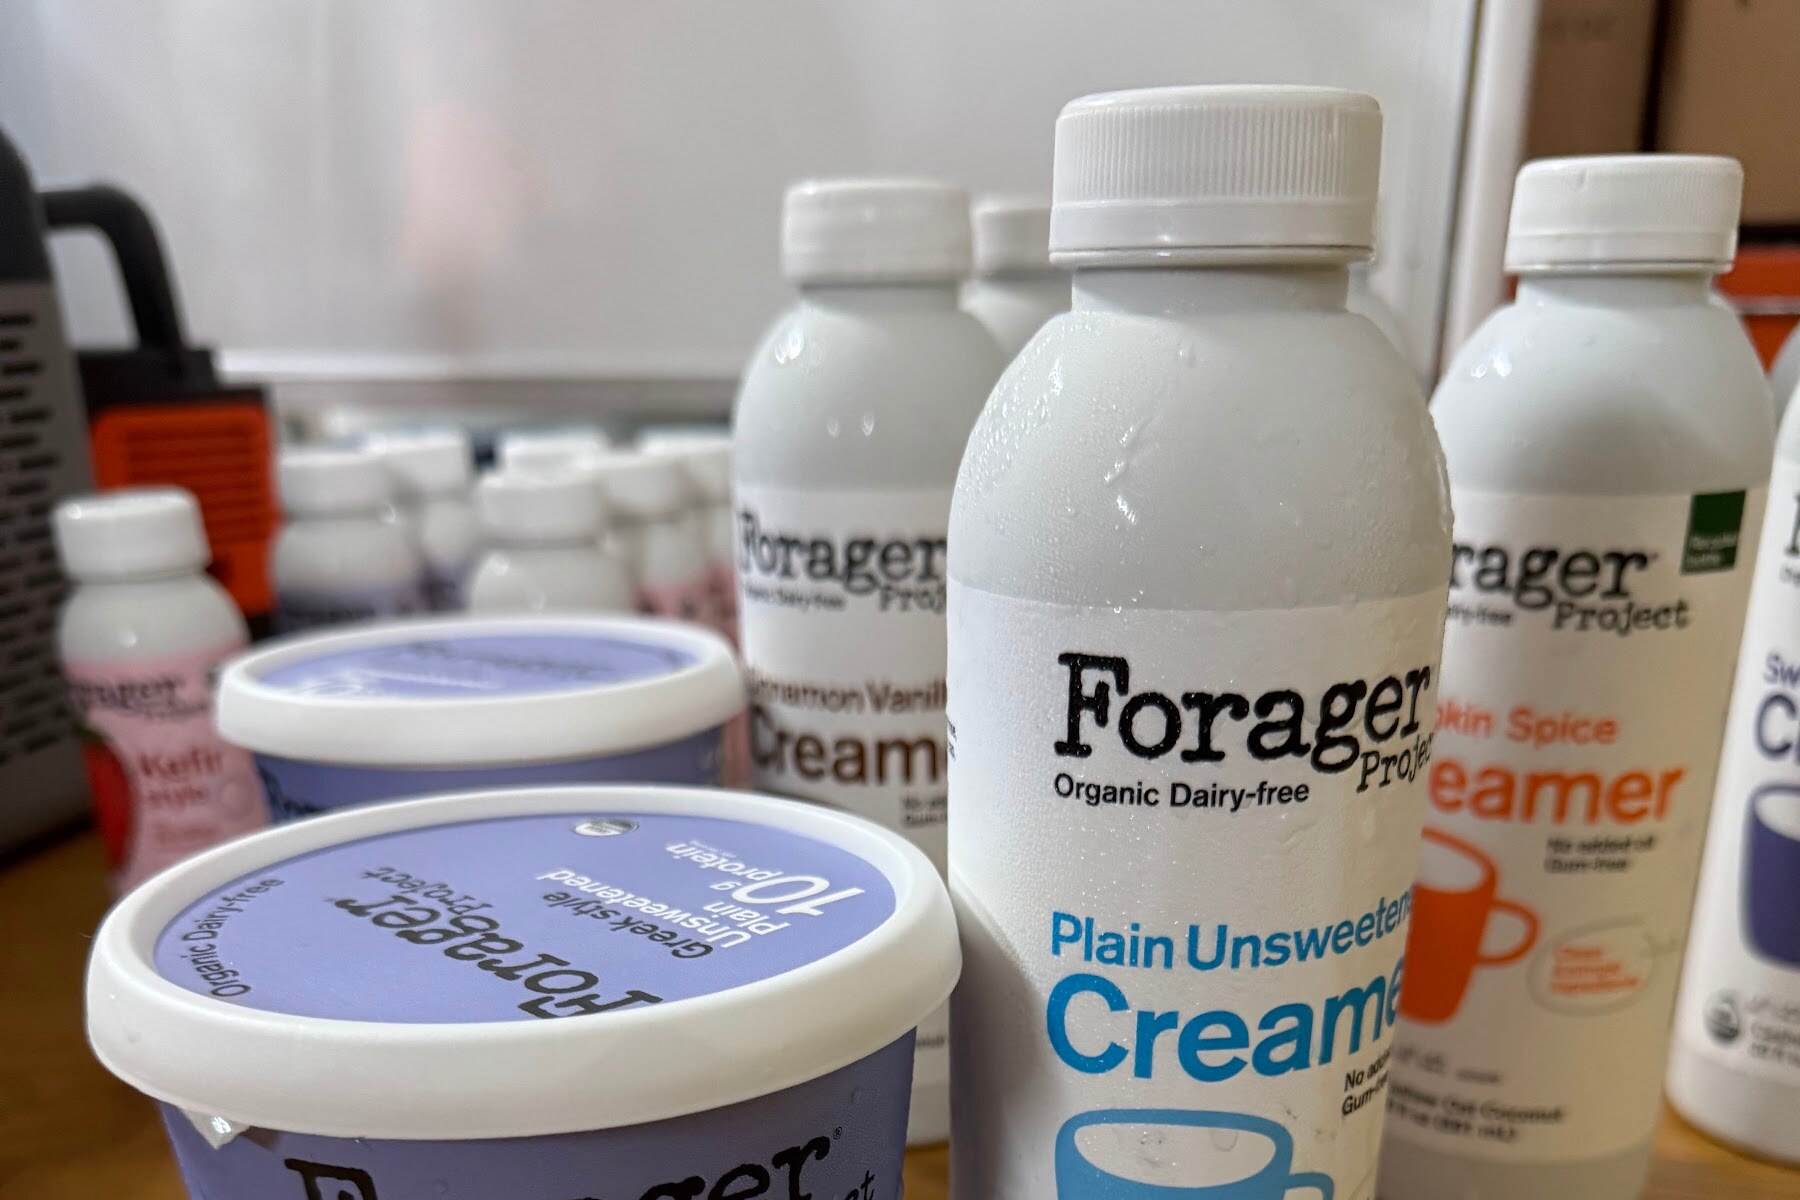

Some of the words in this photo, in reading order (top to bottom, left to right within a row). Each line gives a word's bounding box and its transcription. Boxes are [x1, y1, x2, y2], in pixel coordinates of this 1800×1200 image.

[1451, 544, 1647, 611] rager
[1552, 598, 1692, 636] Project
[865, 679, 947, 712] Vanill
[1053, 652, 1431, 774] Forager
[750, 704, 947, 785] Cream
[1507, 705, 1619, 747] Spice
[1054, 773, 1159, 807] Organic
[1170, 781, 1310, 812] Dairy-free
[1429, 758, 1687, 825] eamer
[665, 842, 784, 881] protein
[182, 879, 285, 942] Dairy-free
[363, 866, 496, 915] Project
[537, 870, 752, 949] Unsweetened
[543, 890, 621, 921] style
[732, 875, 865, 917] 10
[609, 915, 714, 960] Greek
[703, 901, 792, 937] Plain
[1051, 911, 1175, 970] Plain
[1187, 889, 1411, 971] Unsweeten
[181, 942, 251, 998] Organic
[333, 895, 663, 1019] Forager
[1046, 956, 1405, 1084] Creame
[1344, 1068, 1364, 1093] No
